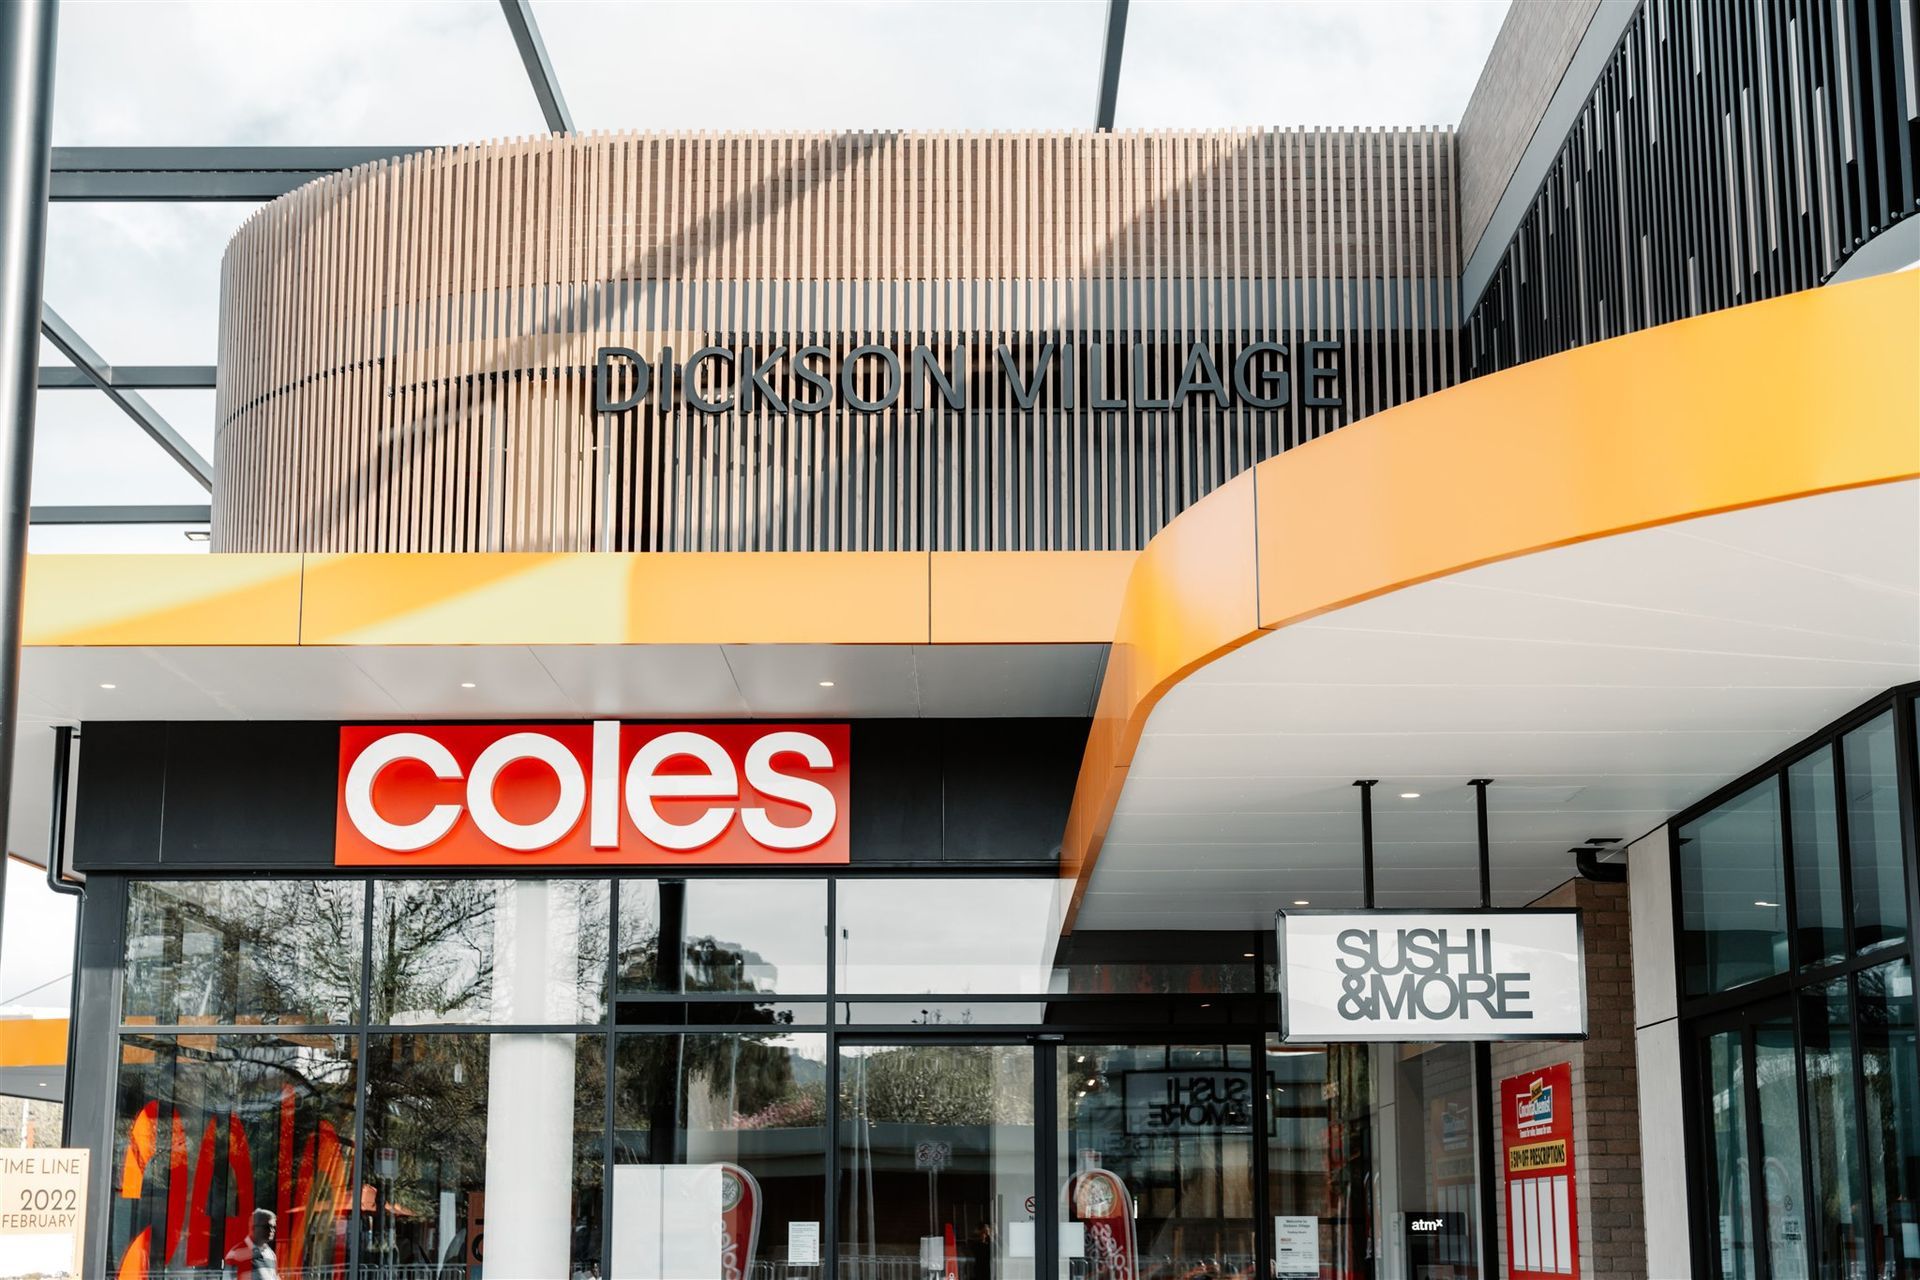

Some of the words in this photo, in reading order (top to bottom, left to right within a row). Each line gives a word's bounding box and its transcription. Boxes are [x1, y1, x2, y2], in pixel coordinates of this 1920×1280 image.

[597, 345, 965, 413] DICKSON
[997, 341, 1342, 410] VILLAGE
[345, 720, 836, 852] coles
[1336, 928, 1493, 976] SUSHI
[1337, 972, 1534, 1020] &MORE
[42, 1158, 80, 1175] LINE
[1530, 1144, 1565, 1166] PRESCRIPTIONS
[20, 1189, 76, 1211] 2022
[2, 1214, 76, 1228] FEBRUARY
